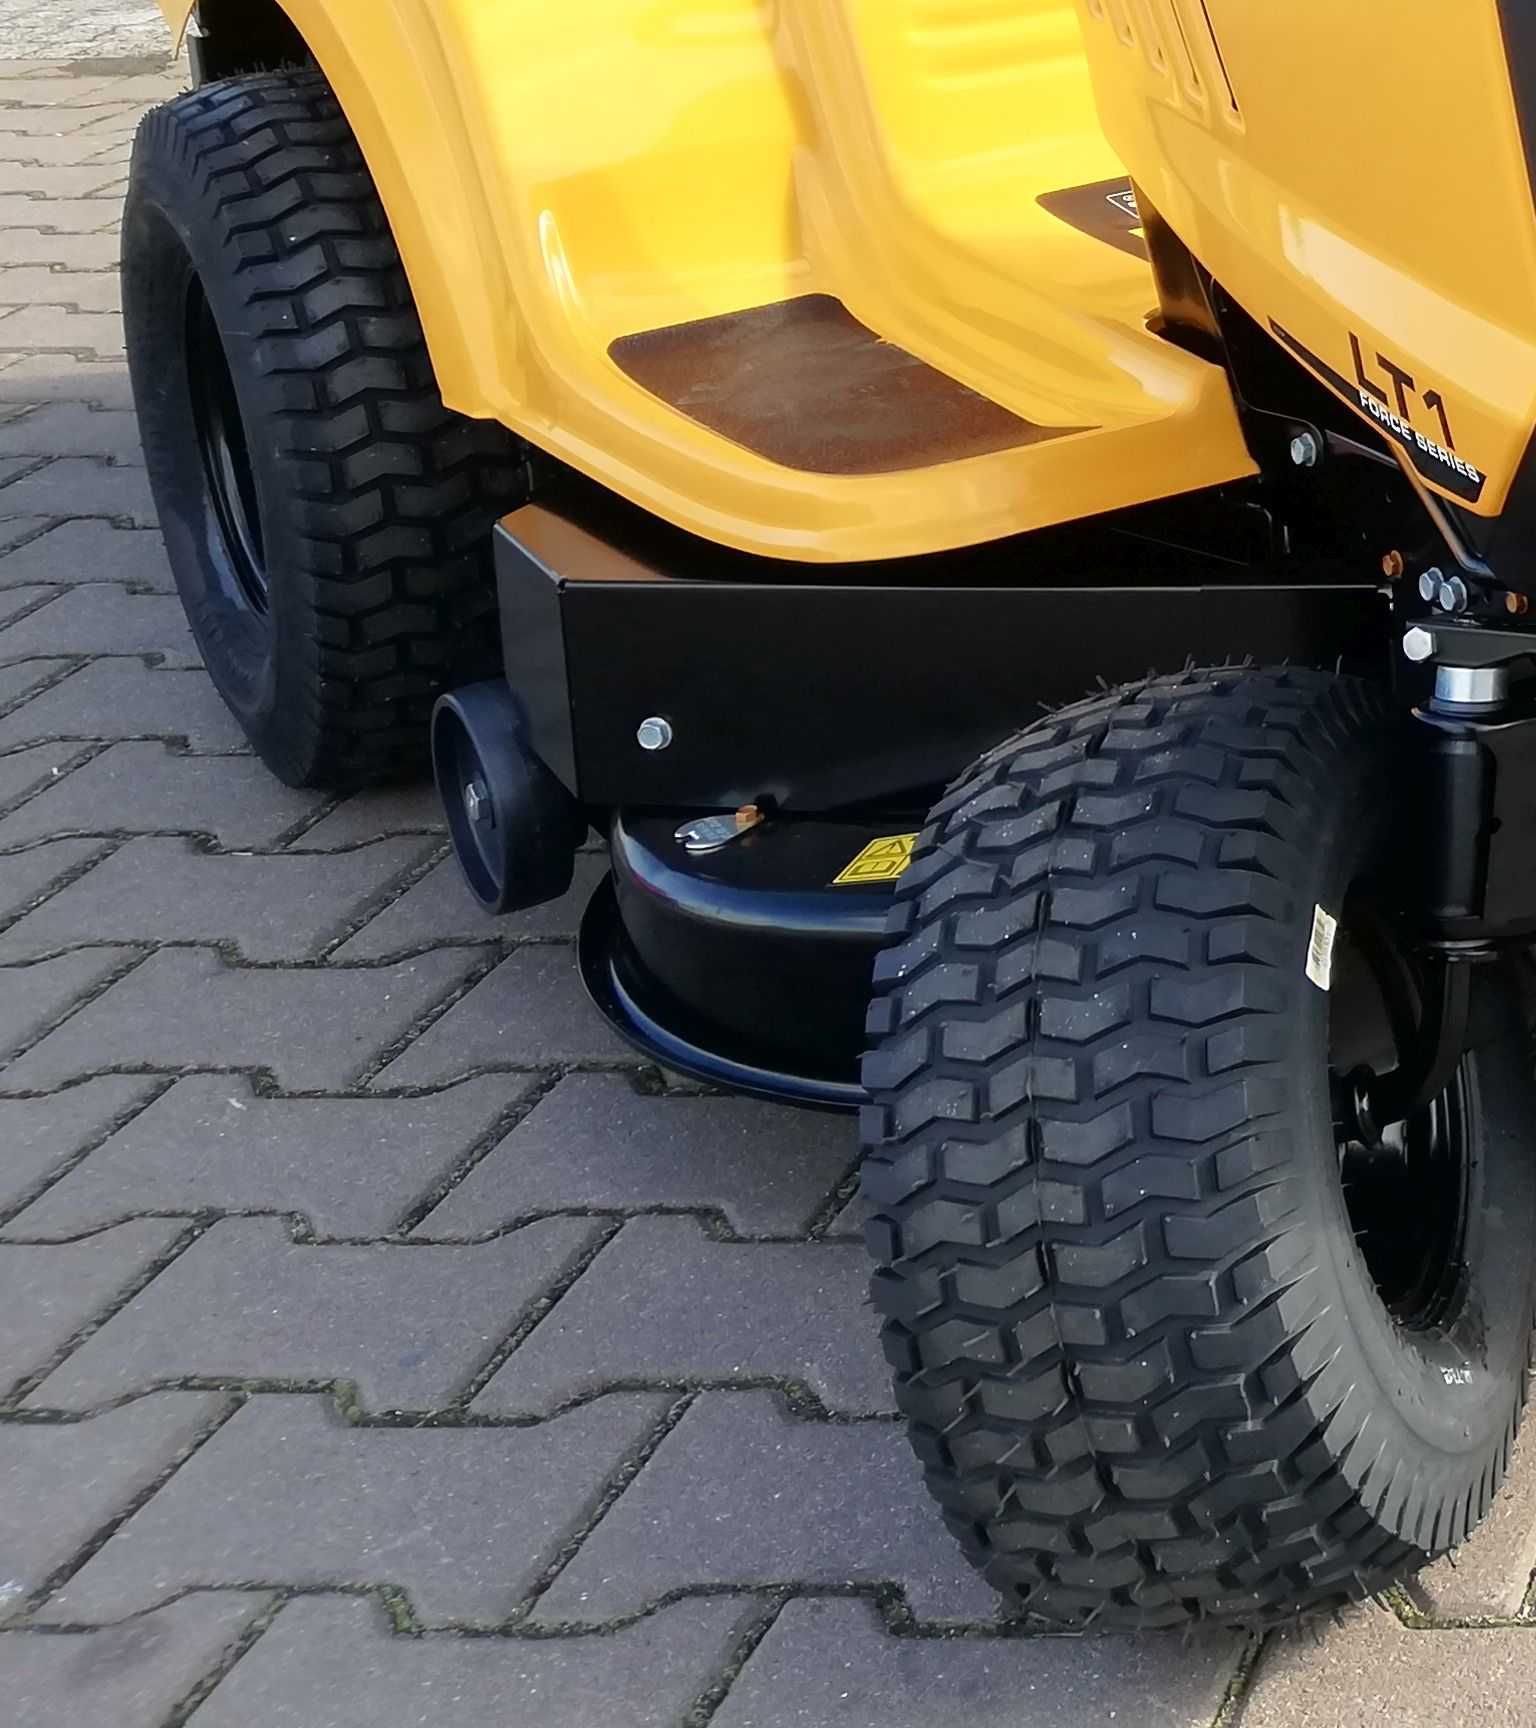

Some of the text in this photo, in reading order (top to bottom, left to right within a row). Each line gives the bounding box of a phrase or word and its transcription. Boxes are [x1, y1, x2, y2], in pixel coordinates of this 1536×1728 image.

[1348, 331, 1455, 452] LT1
[1358, 389, 1480, 483] FORCE SERIES
